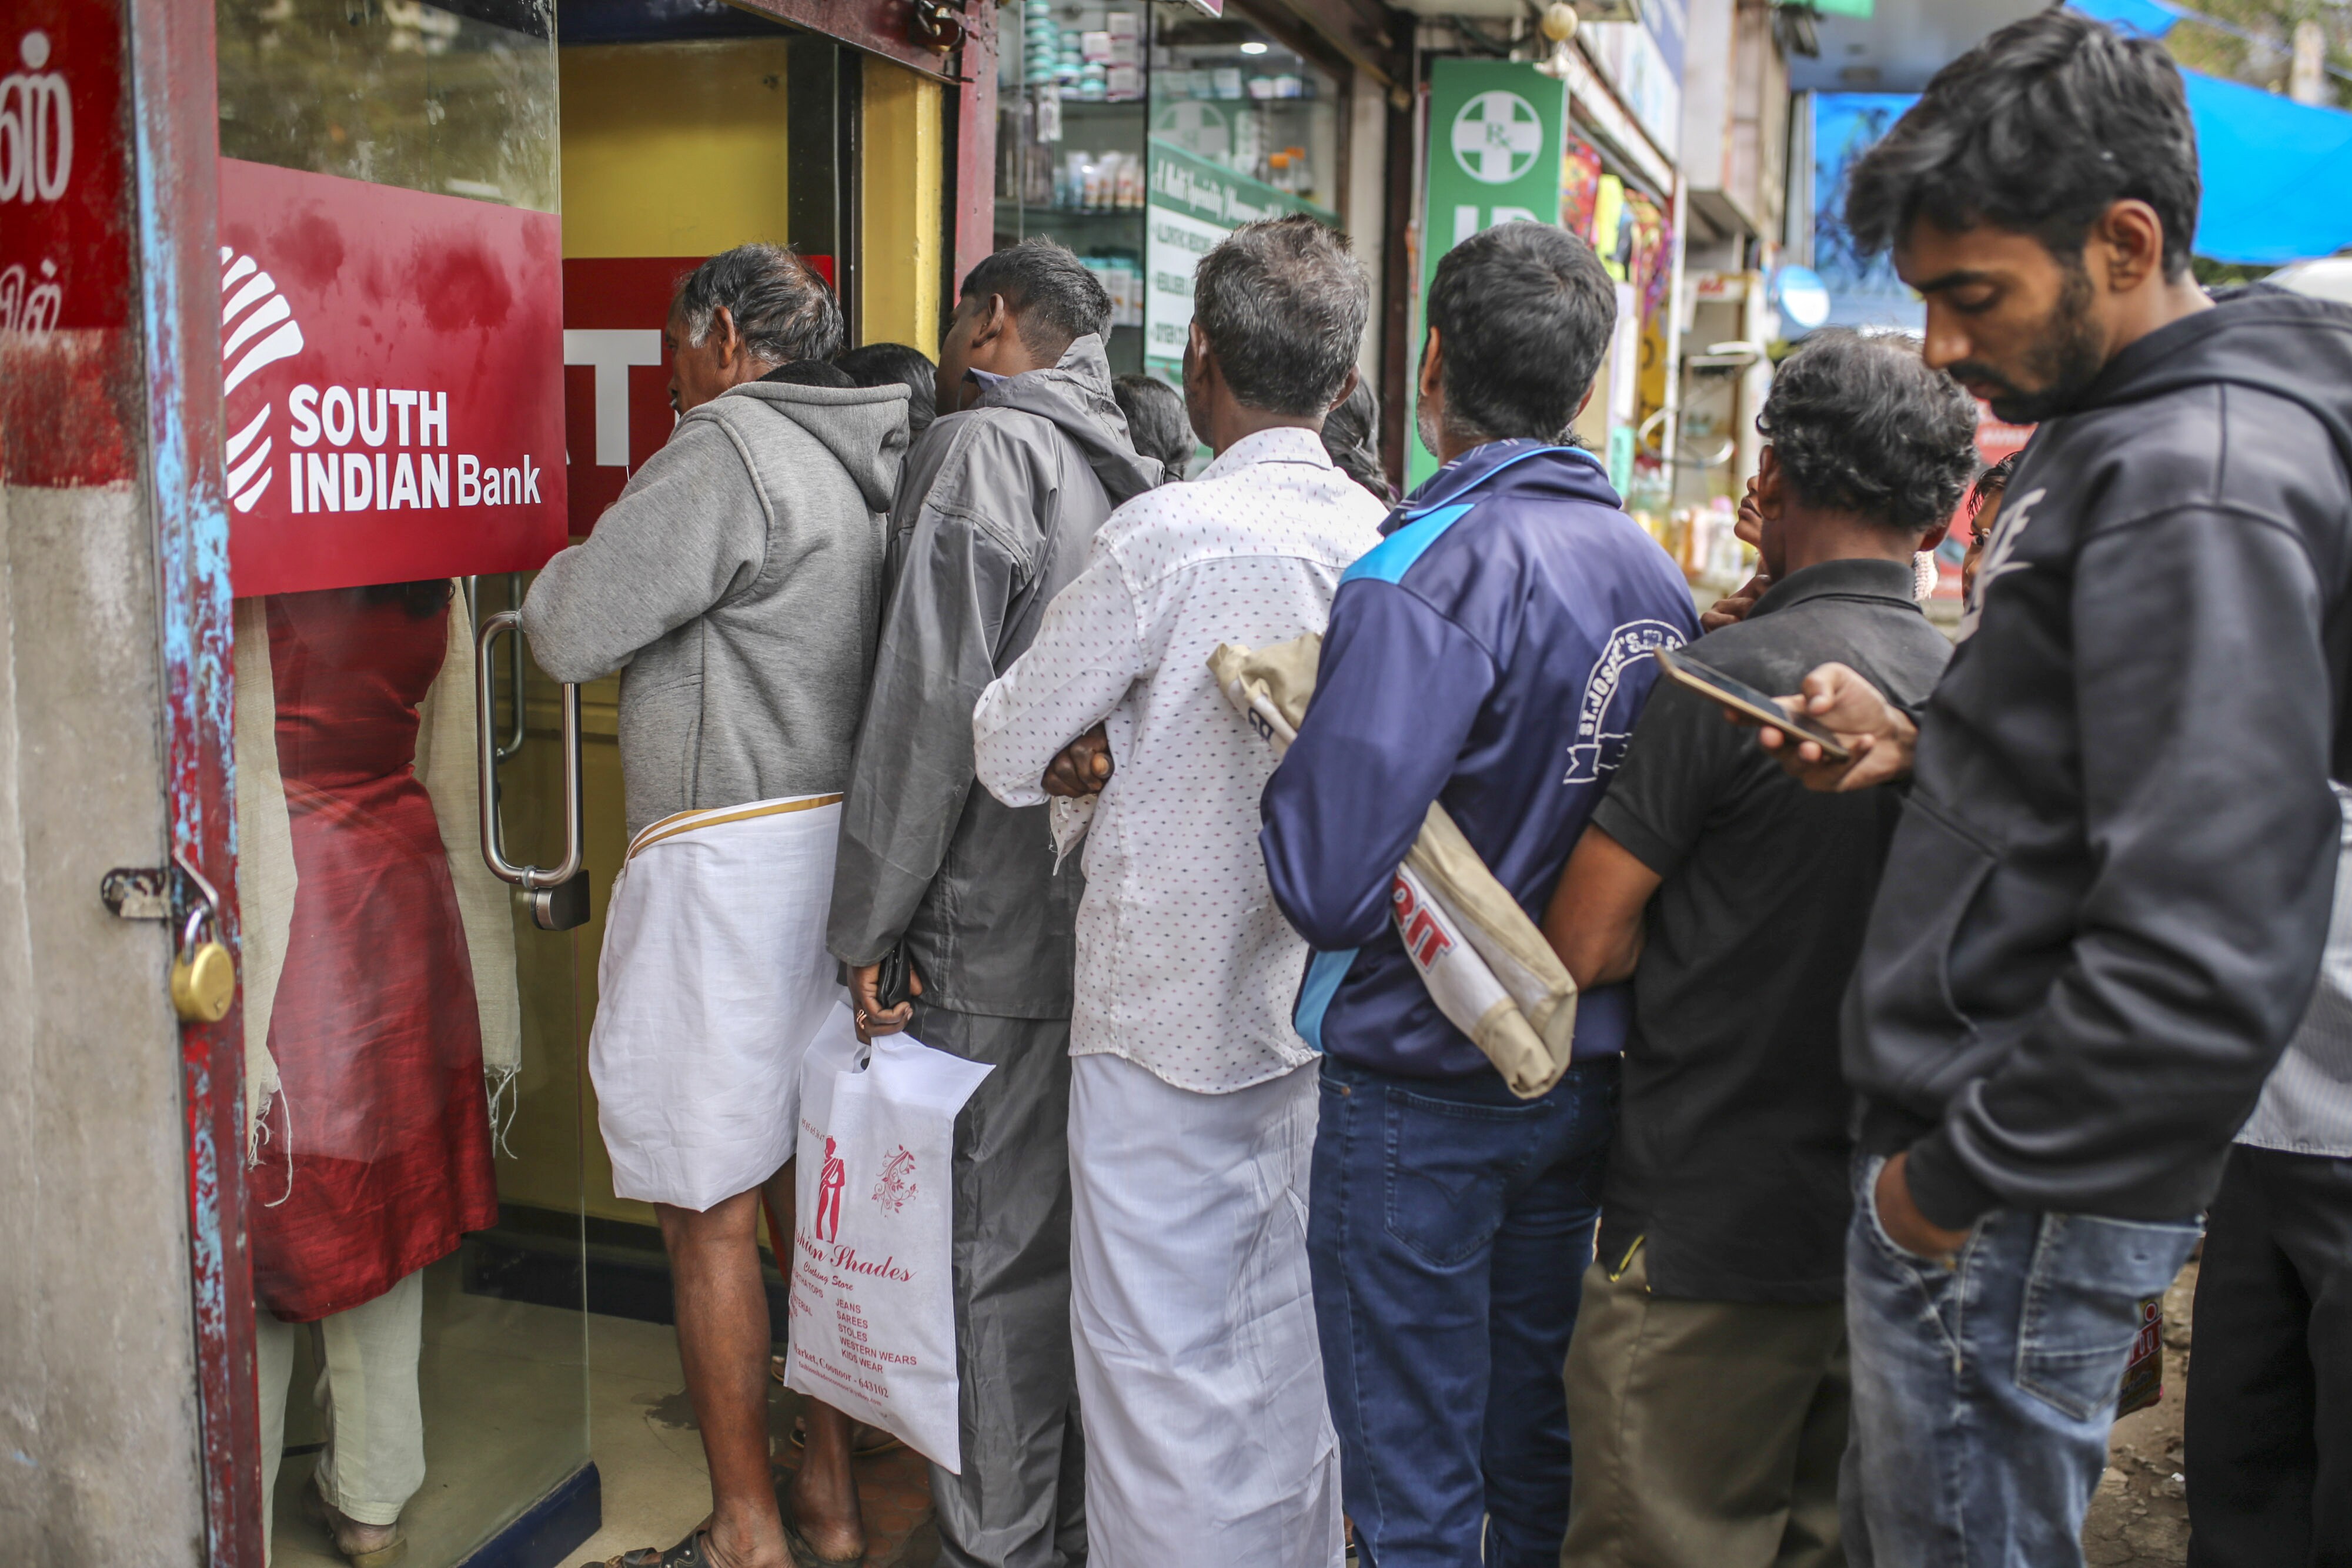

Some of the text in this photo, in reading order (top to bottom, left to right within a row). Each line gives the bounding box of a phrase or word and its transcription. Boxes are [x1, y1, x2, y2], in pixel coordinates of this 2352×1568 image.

[288, 383, 447, 447] SOUTH
[289, 452, 542, 514] INDIAN Bank
[830, 1245, 917, 1282] Shades
[831, 1275, 854, 1291] Store
[836, 1298, 861, 1314] JEANS
[837, 1310, 868, 1329] SAREES
[838, 1323, 868, 1342] STOLES
[840, 1335, 917, 1366] WESTERN WEARS
[841, 1349, 883, 1373] KIDS WEAR
[819, 1358, 852, 1382] Coonoor
[858, 1378, 889, 1399] 643102
